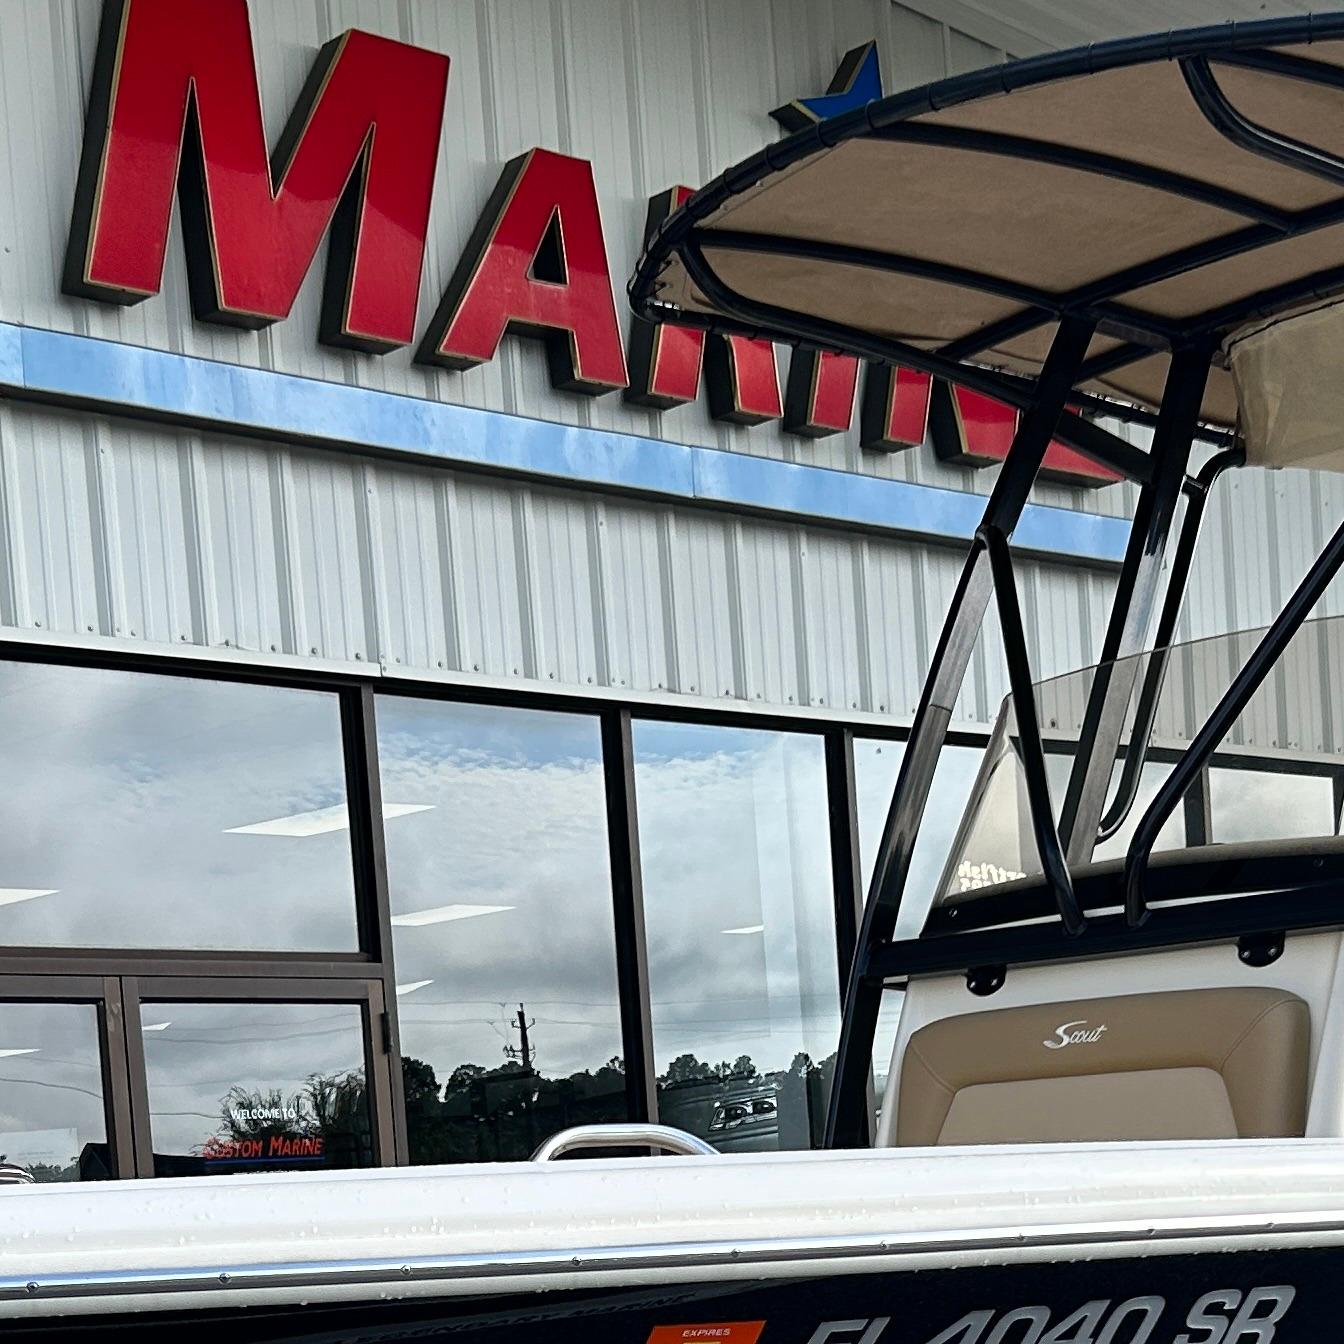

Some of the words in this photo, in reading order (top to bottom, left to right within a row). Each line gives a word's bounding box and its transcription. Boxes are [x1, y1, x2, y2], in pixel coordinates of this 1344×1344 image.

[1042, 1020, 1108, 1050] Scout
[230, 1108, 280, 1121] WELCOME
[282, 1108, 296, 1120] TO
[203, 1137, 263, 1159] CUSTOM
[269, 1136, 325, 1157] MARINE
[682, 1328, 731, 1338] EXPIRES
